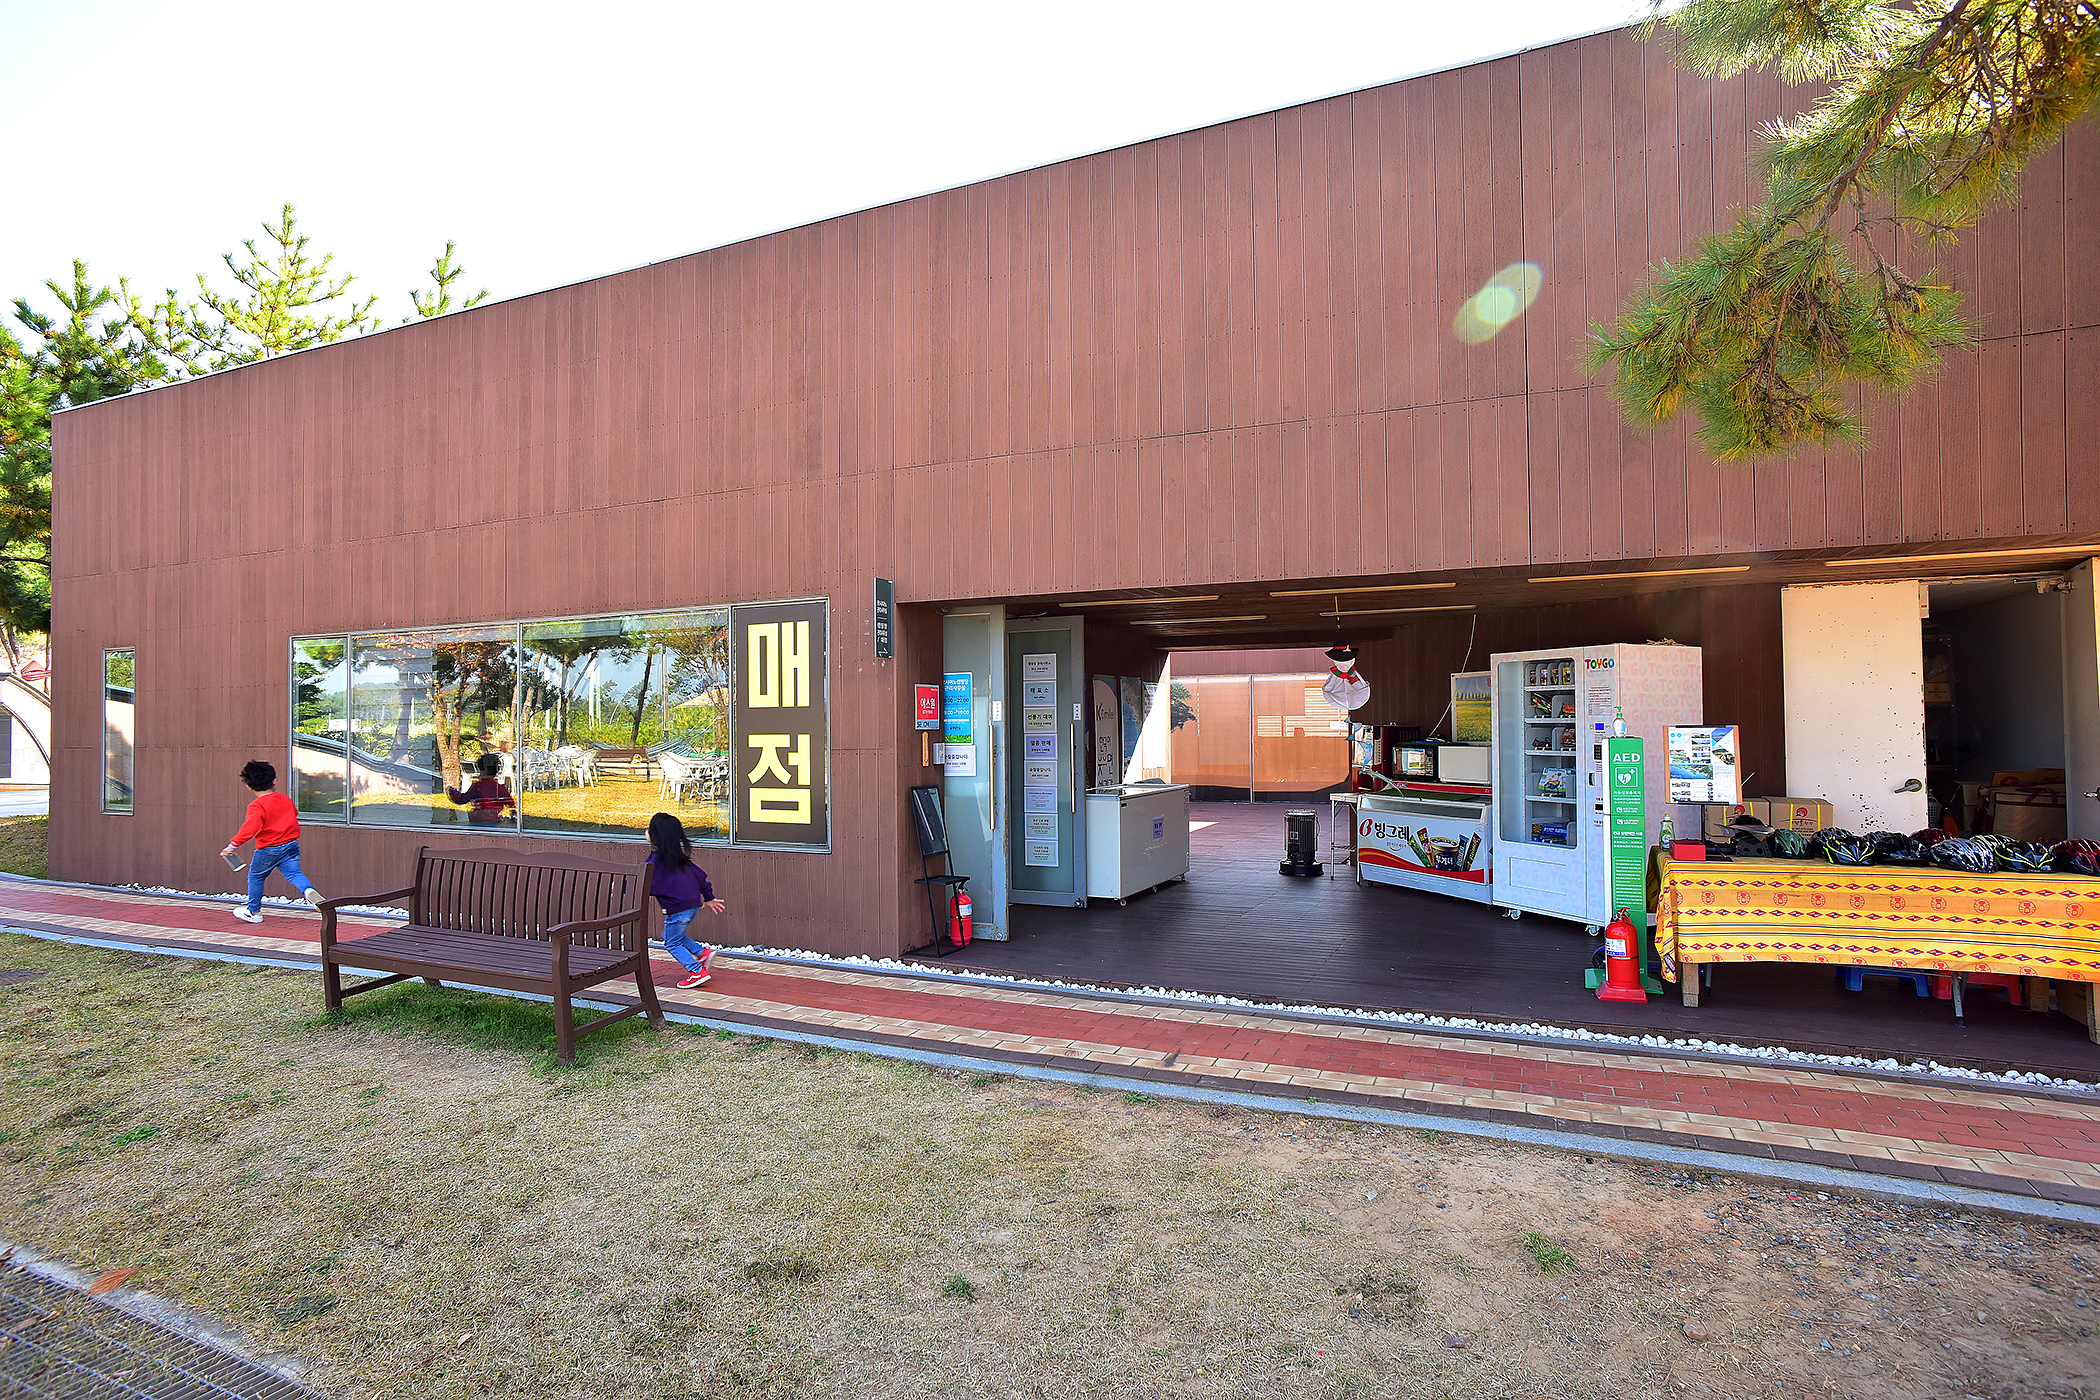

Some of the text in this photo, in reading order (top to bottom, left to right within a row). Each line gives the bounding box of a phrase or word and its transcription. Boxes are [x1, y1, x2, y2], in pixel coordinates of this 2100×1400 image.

[1584, 658, 1615, 670] TOYGO
[921, 698, 936, 709] 에스원
[747, 620, 812, 826] 매점
[1613, 753, 1641, 763] AED
[1374, 821, 1410, 843] 빙그레
